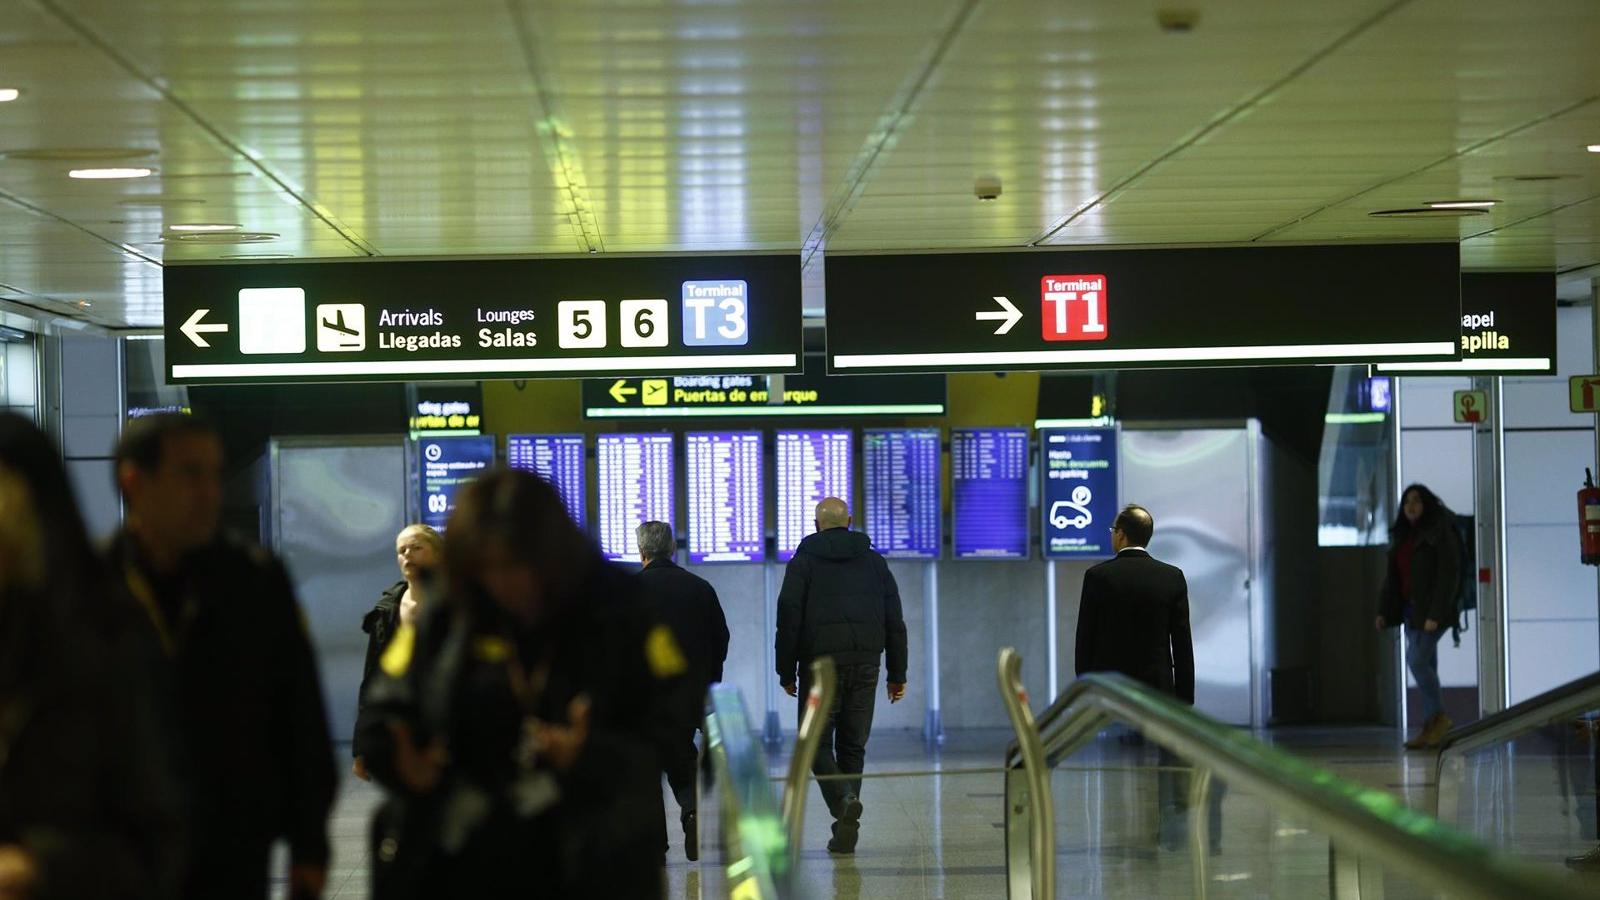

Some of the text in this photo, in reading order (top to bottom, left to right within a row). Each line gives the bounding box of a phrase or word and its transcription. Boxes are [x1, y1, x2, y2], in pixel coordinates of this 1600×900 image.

[687, 284, 743, 297] Terminal
[1046, 278, 1102, 291] Terminal
[379, 308, 443, 326] Arrivals
[477, 307, 535, 325] Lounges
[685, 298, 746, 340] T3
[1044, 291, 1105, 334] T1
[1461, 310, 1494, 330] apel
[572, 310, 593, 339] 5
[634, 308, 655, 338] 6
[379, 331, 462, 352] Llegadas
[478, 327, 538, 348] Salas
[1461, 331, 1510, 353] apilla
[674, 376, 753, 389] Boarding gates
[674, 388, 818, 405] Puertas de emrque
[428, 493, 447, 513] 03
